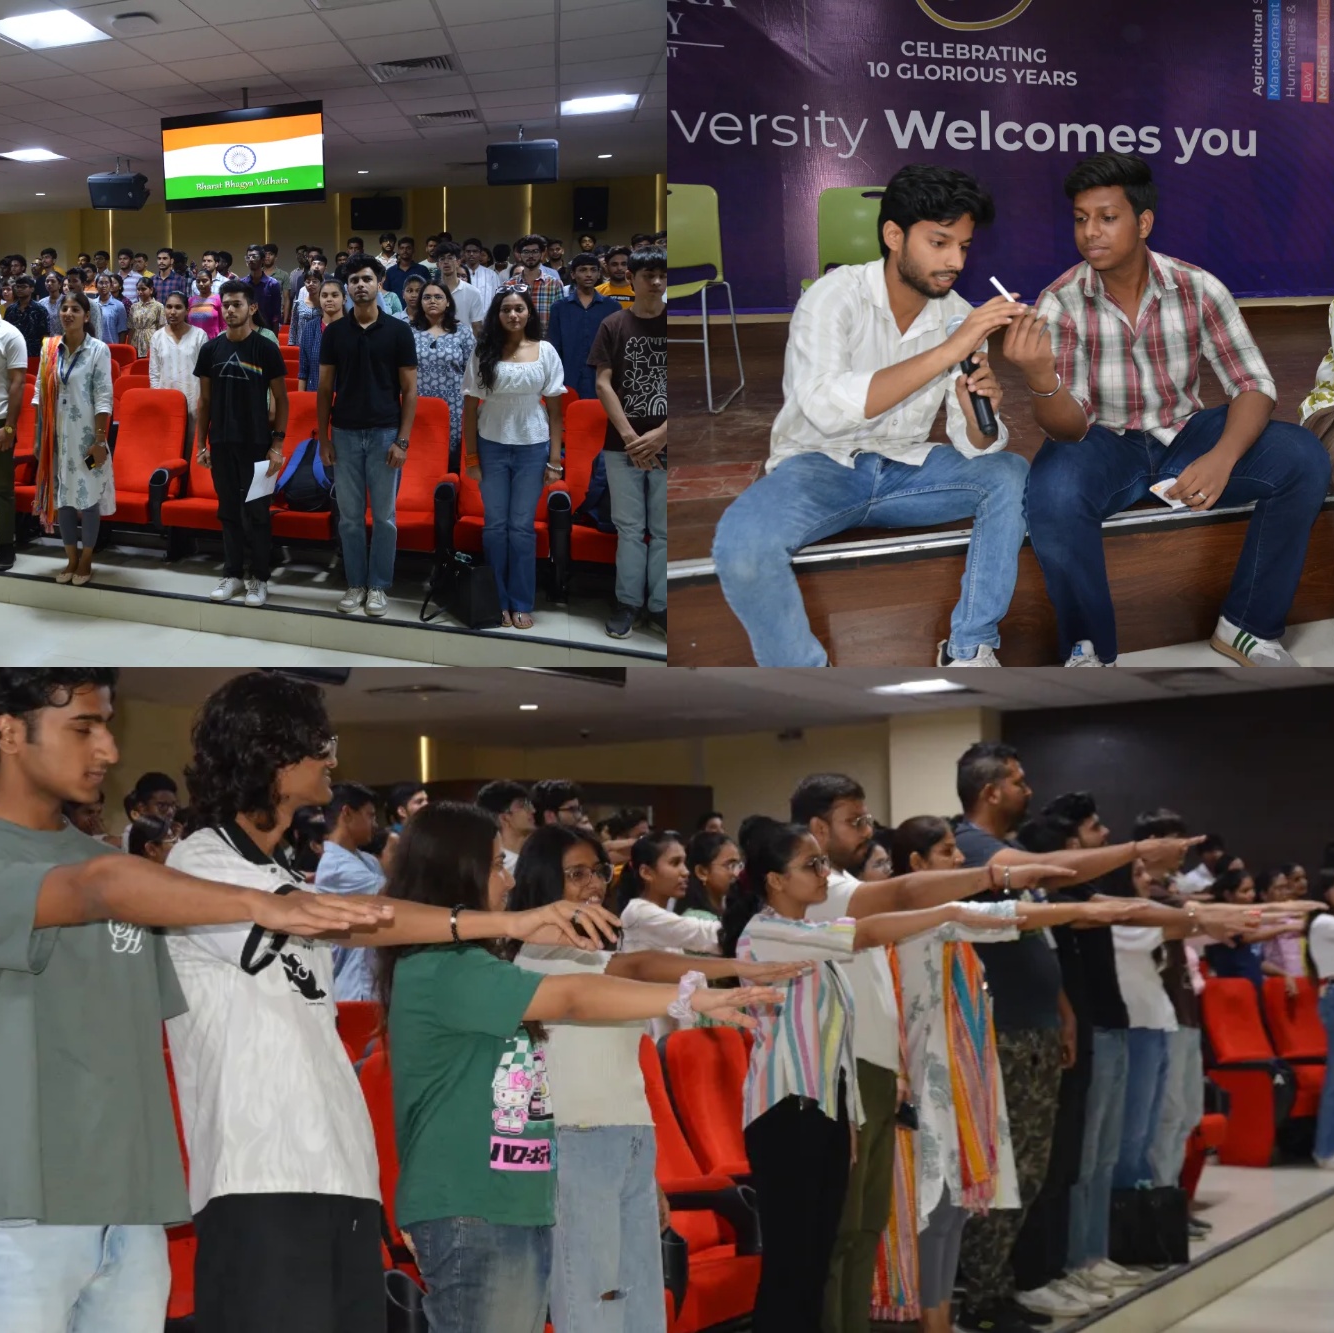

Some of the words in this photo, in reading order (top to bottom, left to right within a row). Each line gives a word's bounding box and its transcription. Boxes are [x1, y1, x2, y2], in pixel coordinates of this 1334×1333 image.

[1287, 4, 1296, 13] &
[900, 40, 1047, 64] CELEBRATING
[1252, 9, 1265, 96] Agricultural
[1269, 3, 1281, 97] Management
[1285, 18, 1296, 97] Humanities
[867, 61, 890, 79] 10
[896, 63, 1007, 84] GLORIOUS
[1012, 68, 1078, 87] YEARS
[1301, 71, 1312, 98] Law
[1318, 45, 1327, 100] Medical
[670, 104, 869, 159] versity
[883, 108, 1162, 155] Welcomes
[1174, 125, 1258, 166] you
[196, 182, 223, 191] Bharat
[255, 176, 289, 186] Vidhata
